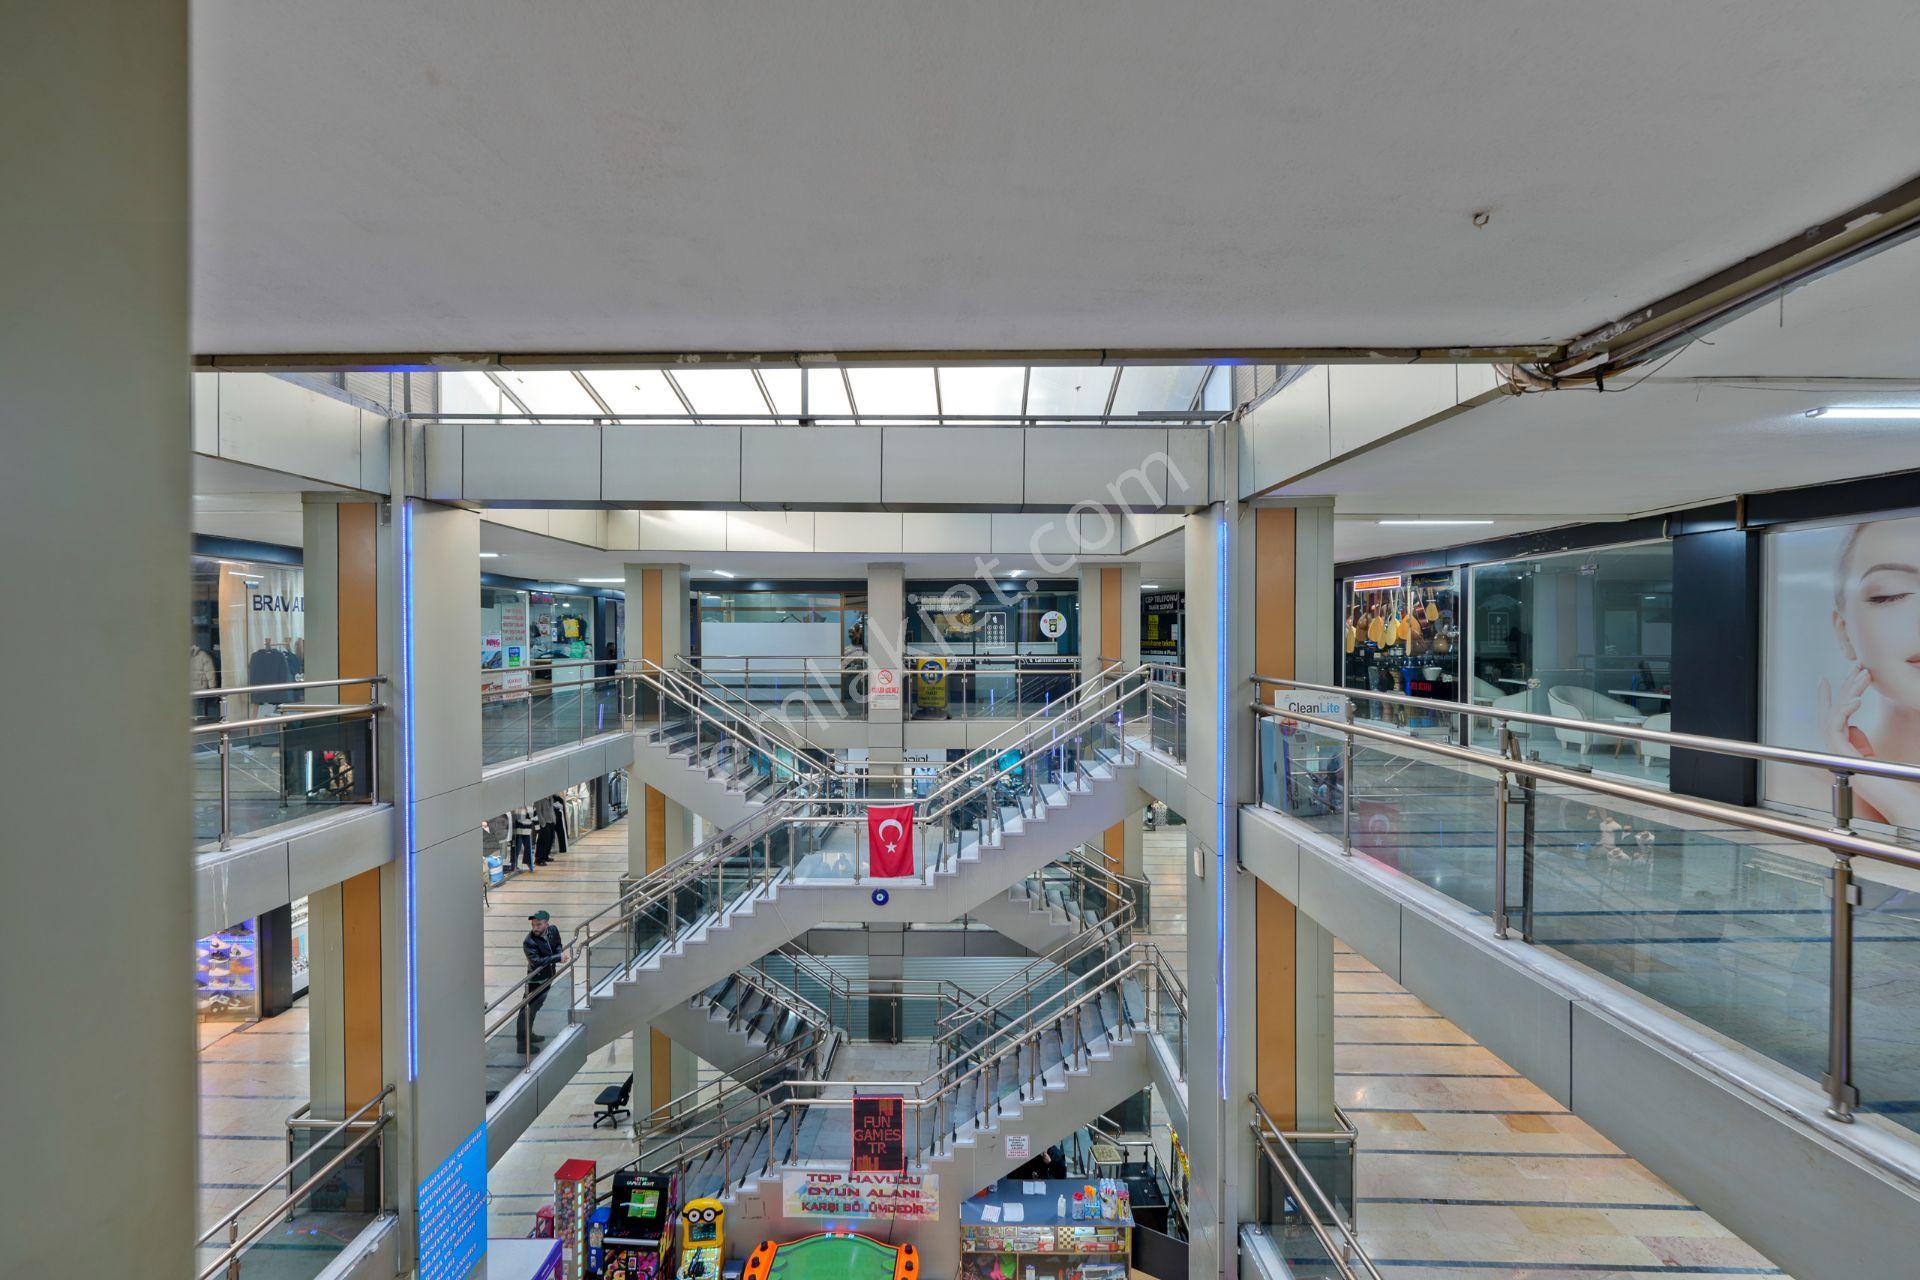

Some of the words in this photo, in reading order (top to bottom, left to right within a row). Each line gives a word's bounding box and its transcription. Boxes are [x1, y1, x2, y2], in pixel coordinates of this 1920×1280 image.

[1288, 702, 1340, 714] CleanLite
[864, 1115, 890, 1128] FUN
[854, 1128, 902, 1141] GAMES
[867, 1141, 887, 1154] TR
[806, 1173, 842, 1185] TOP
[847, 1173, 921, 1185] HAVUZU
[806, 1186, 860, 1197] OYUN
[865, 1187, 921, 1199] ALANI
[801, 1201, 839, 1214] KARŞI
